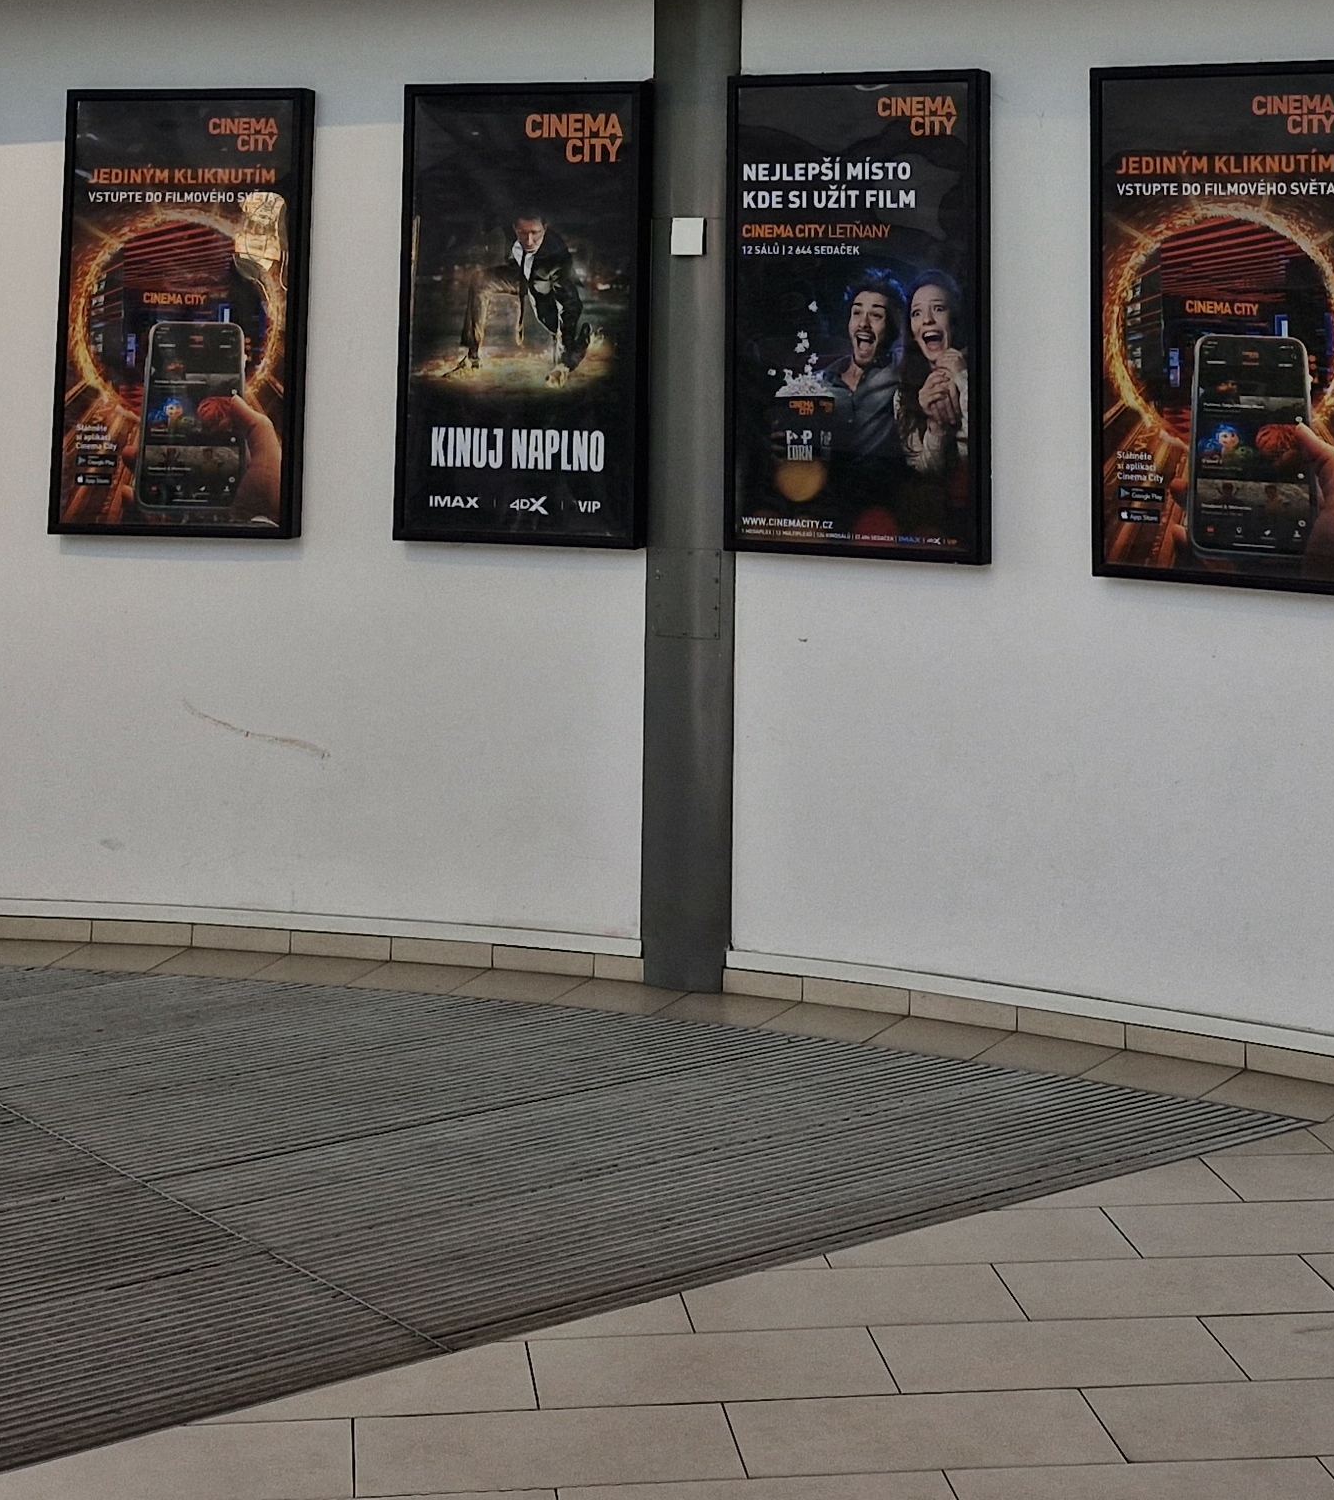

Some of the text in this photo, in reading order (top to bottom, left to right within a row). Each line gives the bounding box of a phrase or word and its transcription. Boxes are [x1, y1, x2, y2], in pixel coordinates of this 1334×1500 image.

[877, 96, 957, 117] CINEMA
[209, 118, 278, 135] CINEMA
[526, 113, 623, 138] CINEMA
[910, 115, 957, 136] CITY
[237, 135, 278, 151] CITY
[566, 138, 623, 163] CITY
[742, 157, 911, 181] NEJLEPŠÍ MÍSTO
[1116, 150, 1208, 175] JEDINÝM
[88, 164, 275, 184] JEDINÝM KLIKNUTÍM
[88, 191, 142, 203] VSTUPTE
[146, 192, 161, 203] DO
[165, 188, 234, 203] FILMOVÉHO
[743, 184, 916, 208] KDE SI UŽÍT FILM
[1117, 182, 1178, 196] VSTUPTE
[1182, 183, 1201, 196] DO
[1205, 178, 1287, 196] FILMOVÉHO
[742, 221, 891, 238] CINEMA CITY LETŇANY
[742, 246, 753, 255] 12
[754, 242, 779, 255] SÁLŮ
[814, 242, 860, 255] SEDAČEK
[143, 292, 182, 305] CINEMA
[184, 293, 207, 306] CITY
[1185, 299, 1259, 316] CINEMA CITY
[431, 427, 605, 472] KINUJ NAPLNO
[1126, 463, 1156, 472] aplikaci
[1117, 472, 1164, 483] Cinema City
[429, 495, 601, 515] IMAX 4DX VIP
[742, 517, 833, 530] WWW.CINEMACITY.CZ
